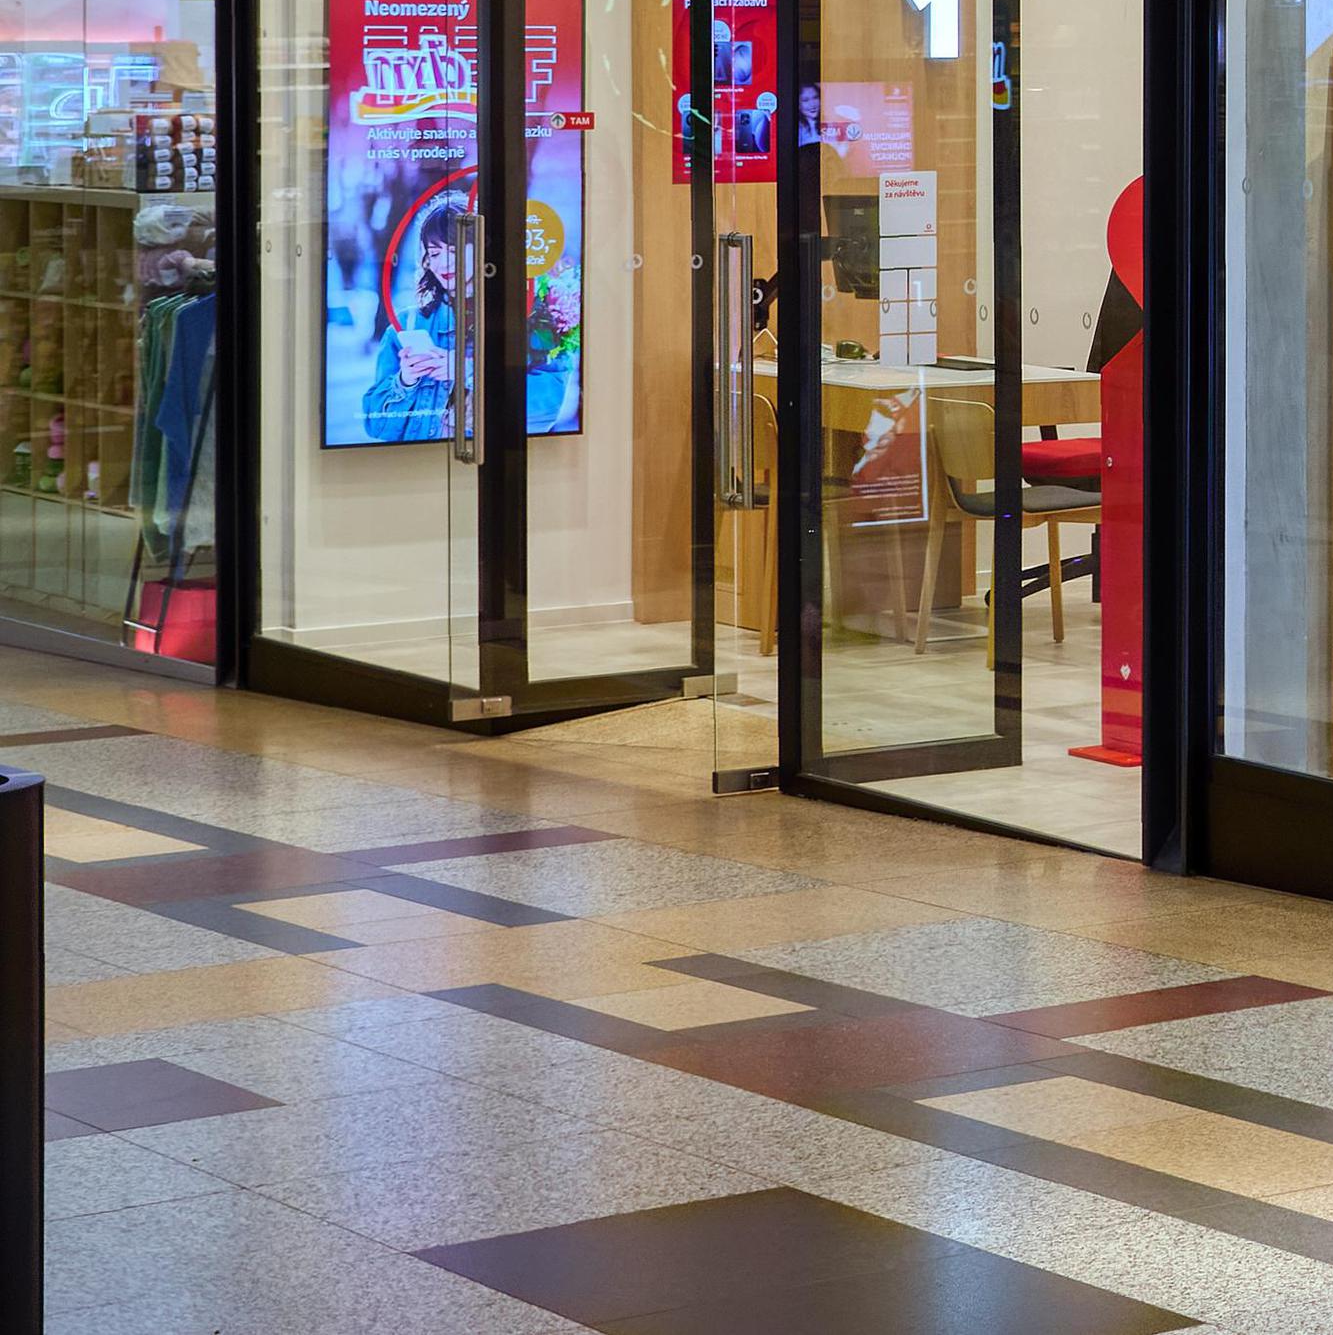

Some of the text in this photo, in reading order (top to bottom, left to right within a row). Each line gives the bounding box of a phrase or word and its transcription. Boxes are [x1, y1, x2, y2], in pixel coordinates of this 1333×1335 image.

[364, 0, 470, 20] Neomezený
[569, 116, 590, 126] TAM
[367, 128, 422, 142] Aktivujte
[469, 129, 477, 139] a
[367, 145, 465, 161] u nás v prodejně
[884, 179, 919, 189] Děkujeme
